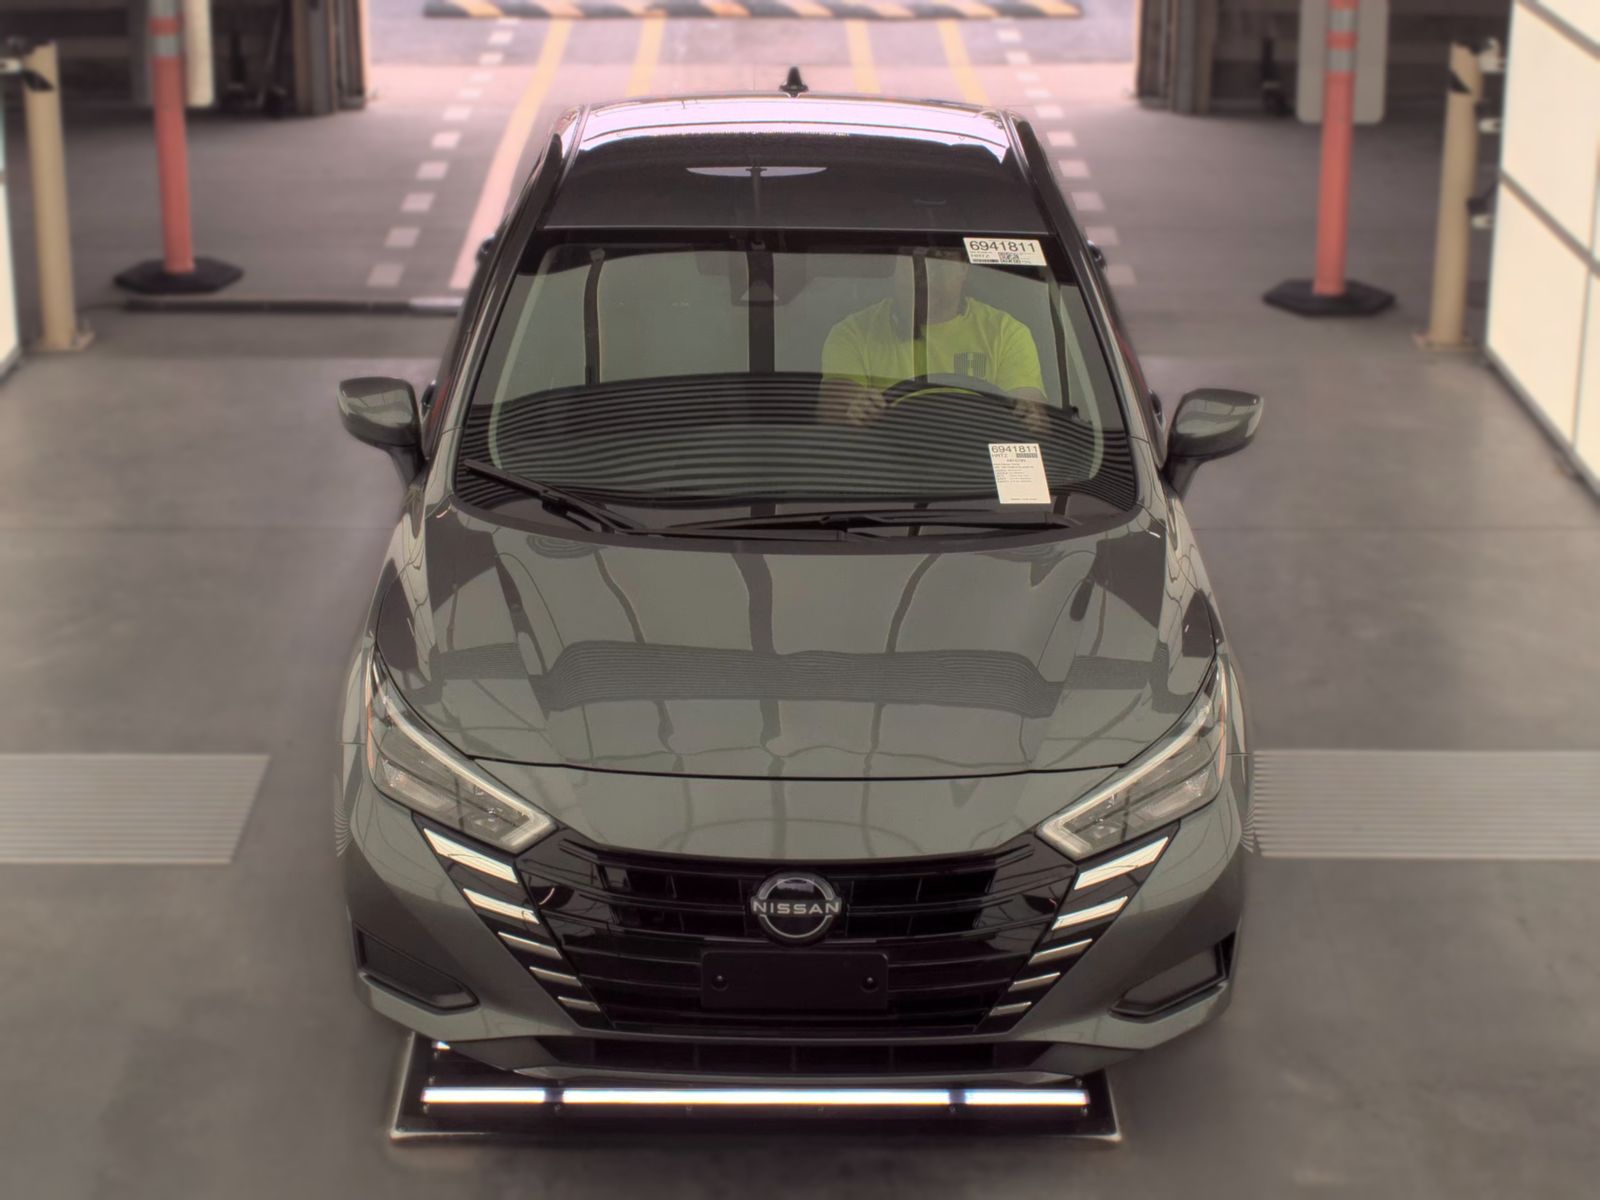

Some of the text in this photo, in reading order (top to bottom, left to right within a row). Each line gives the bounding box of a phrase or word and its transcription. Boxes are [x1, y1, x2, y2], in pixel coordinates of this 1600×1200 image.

[969, 240, 1036, 253] 6941811
[991, 445, 1038, 453] 6941811
[752, 901, 840, 914] NISSAN
